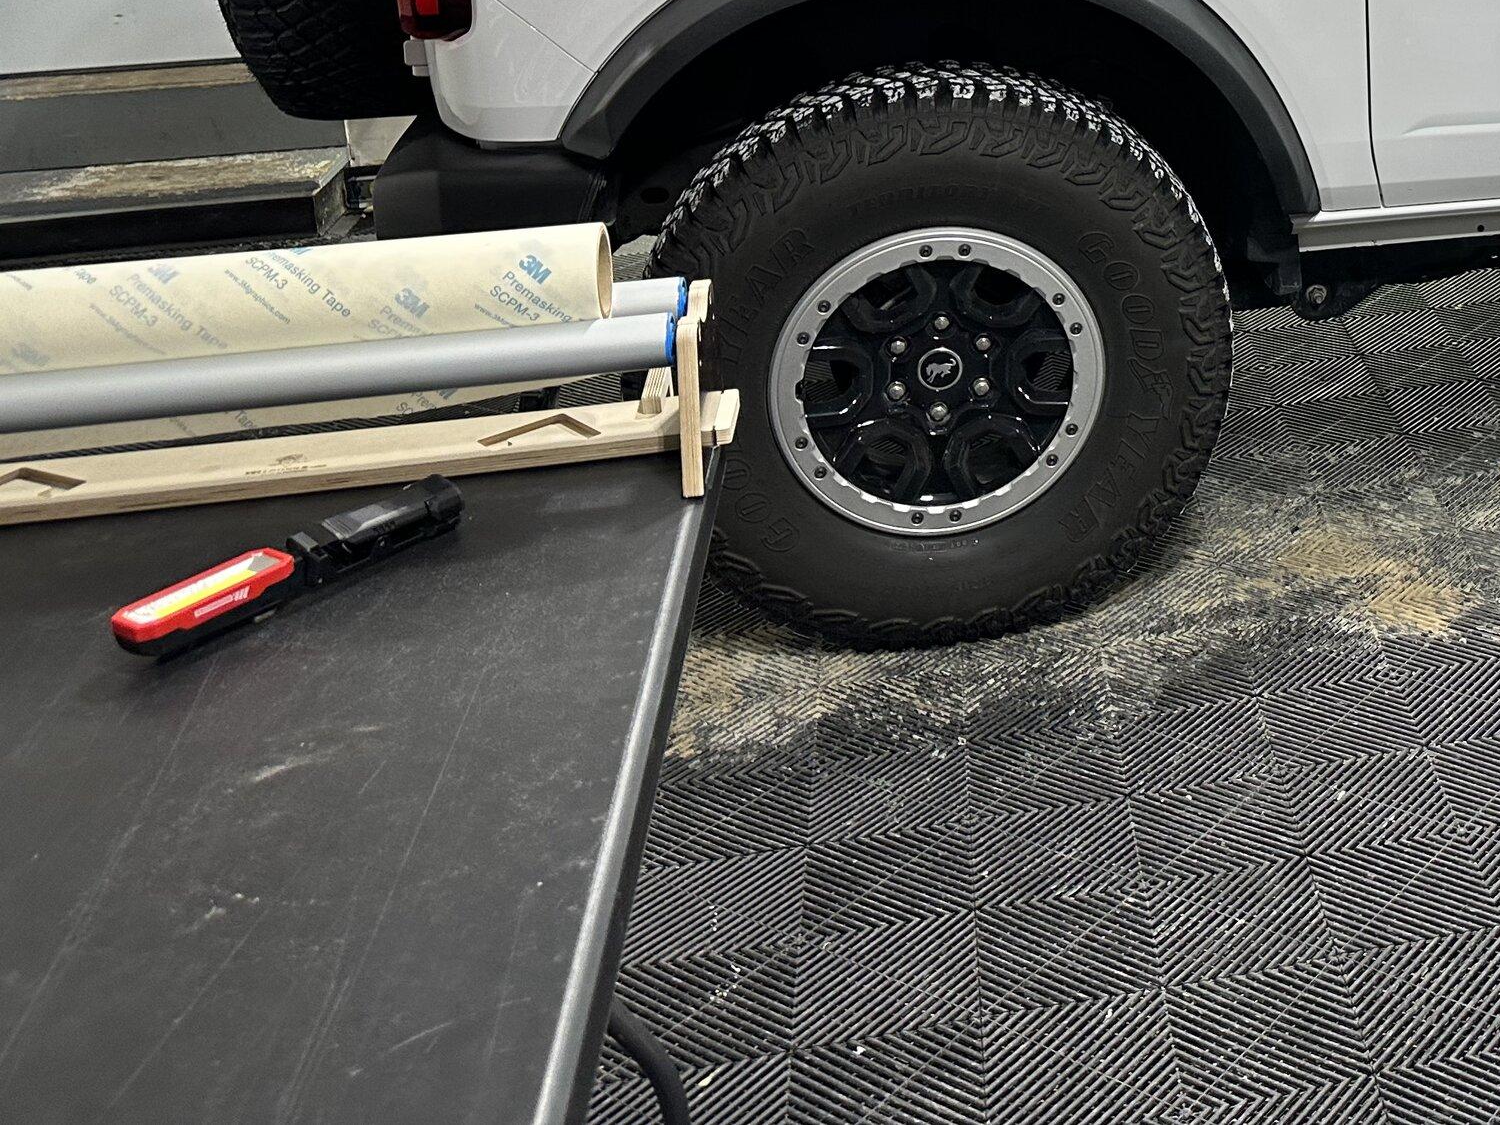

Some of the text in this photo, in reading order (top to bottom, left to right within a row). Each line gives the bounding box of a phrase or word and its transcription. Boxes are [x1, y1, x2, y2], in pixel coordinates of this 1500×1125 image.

[245, 257, 288, 290] SCPM-3
[519, 254, 552, 284] 3M
[109, 284, 159, 328] SCPM-3
[322, 289, 351, 318] Tape
[395, 288, 430, 318] 3M
[490, 285, 541, 322] SCPM-3
[503, 271, 572, 323] Premasking
